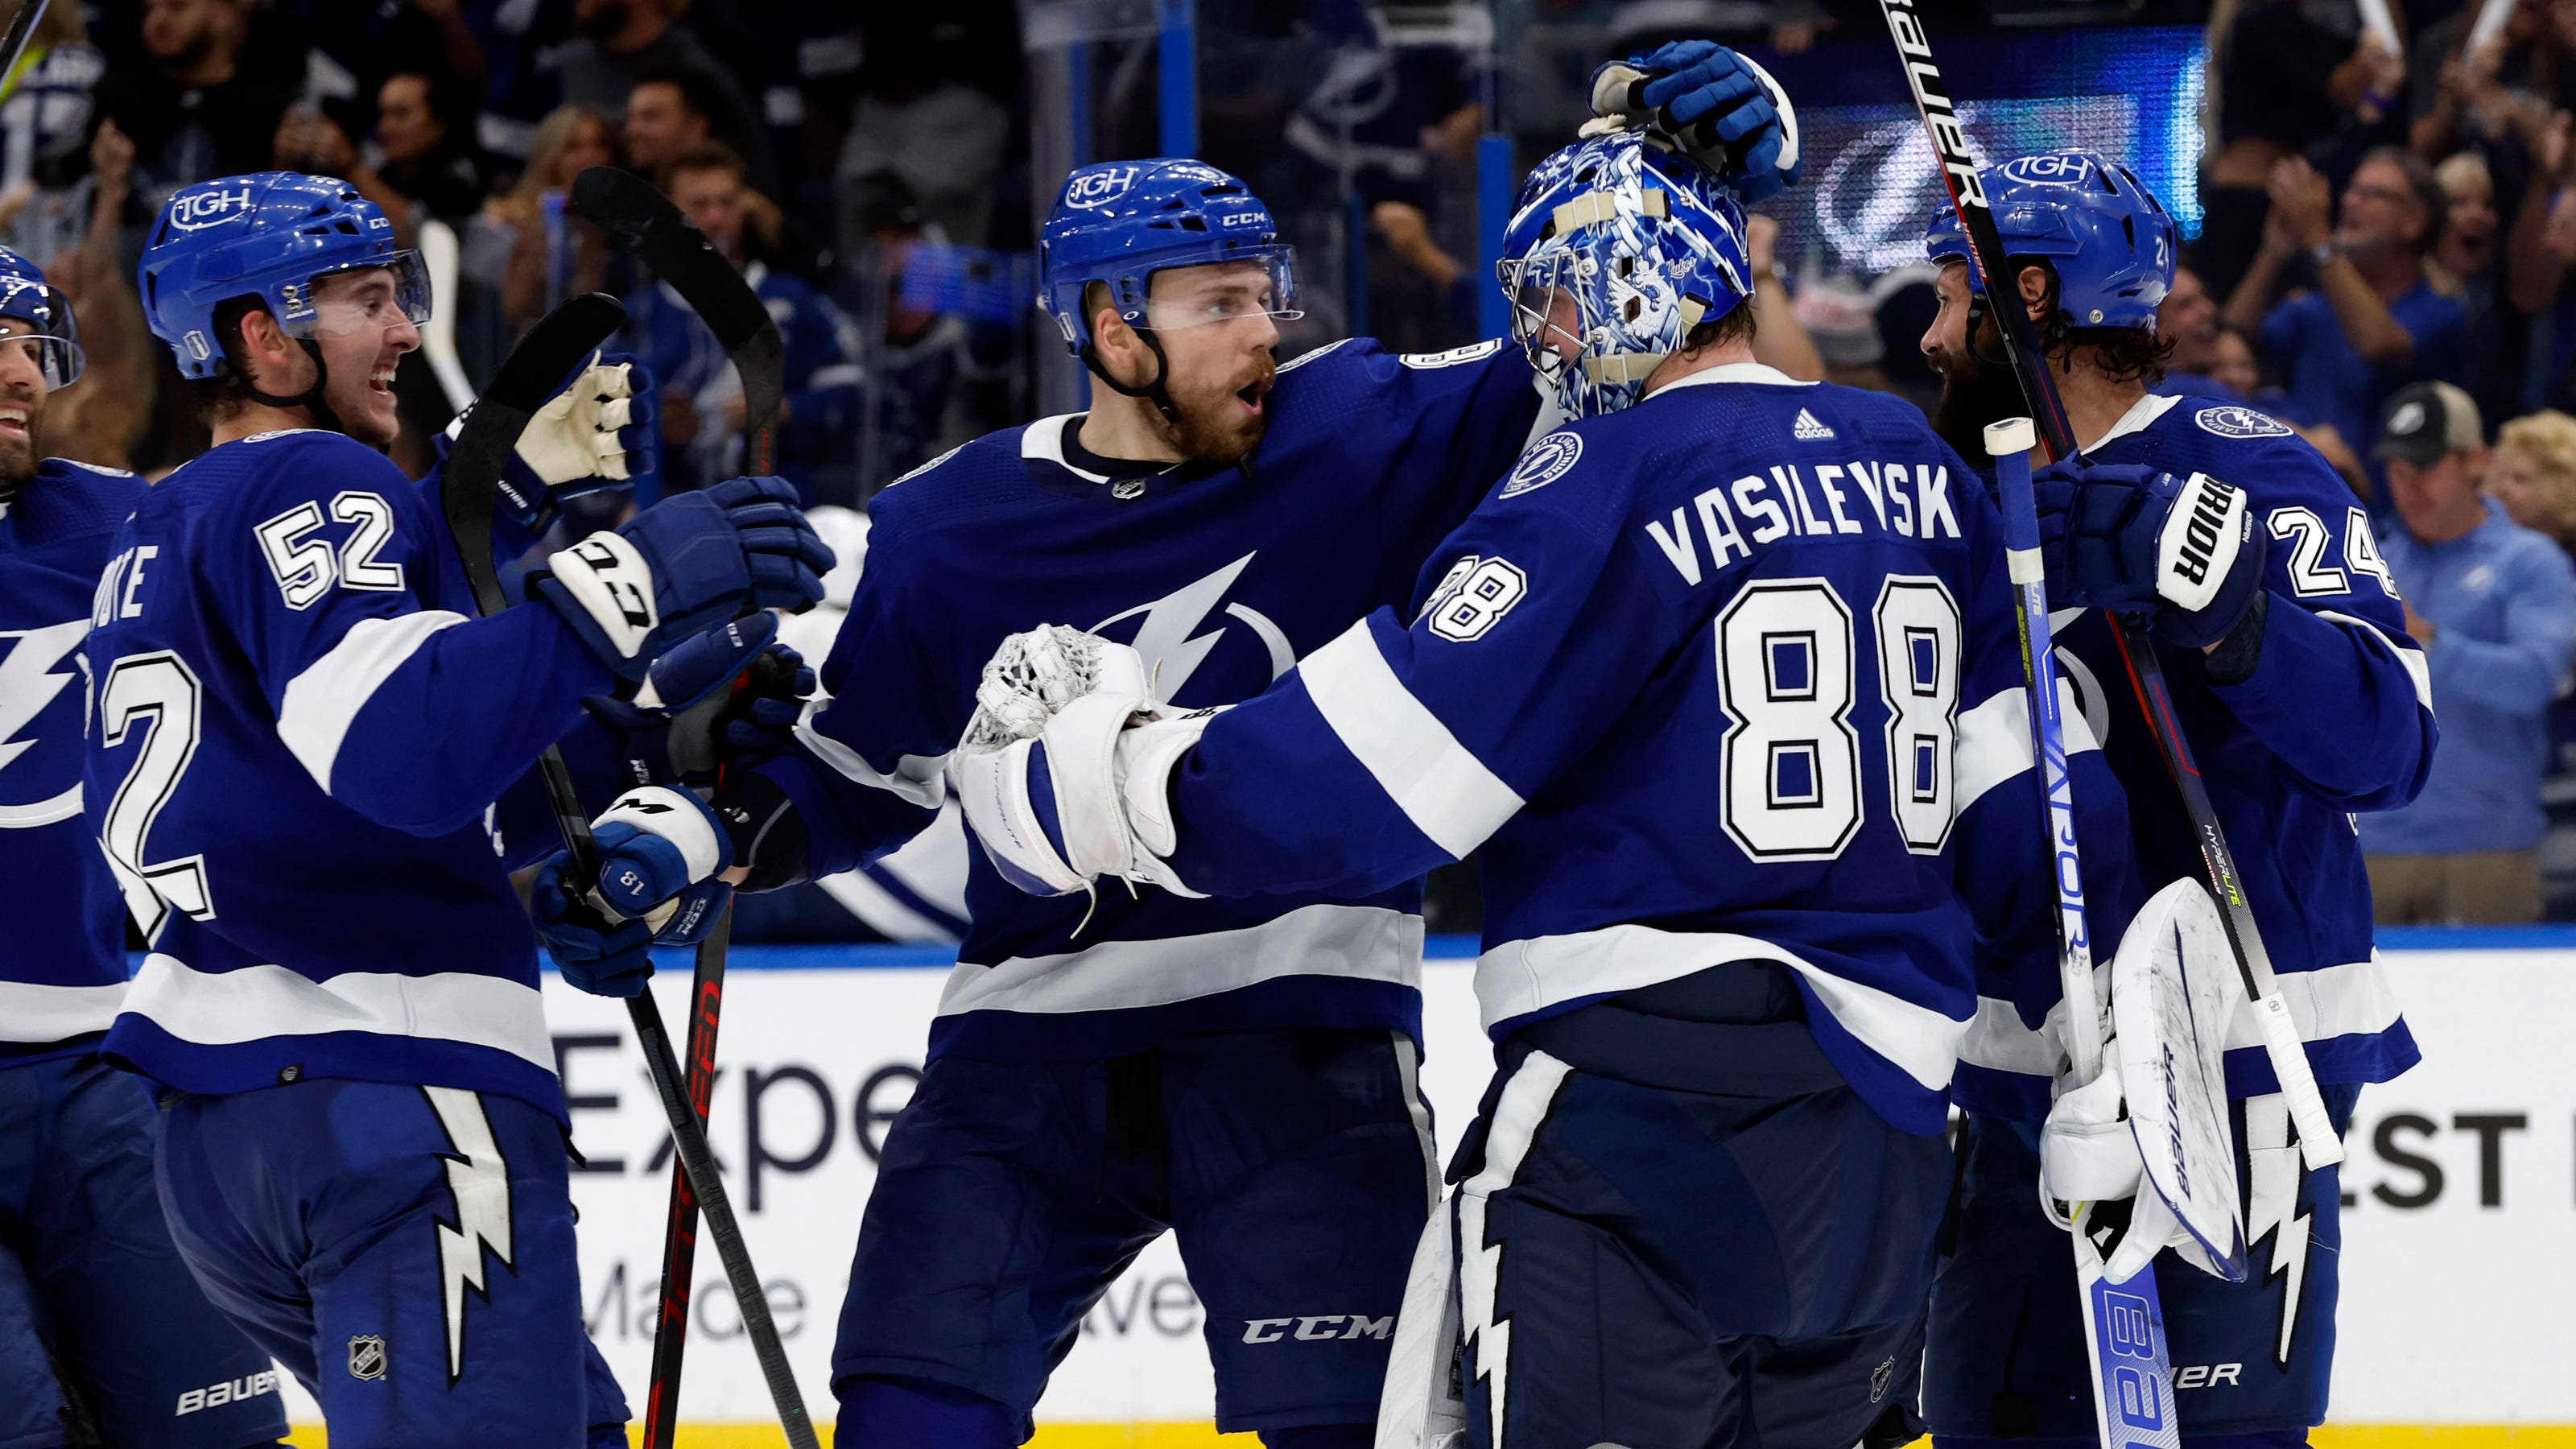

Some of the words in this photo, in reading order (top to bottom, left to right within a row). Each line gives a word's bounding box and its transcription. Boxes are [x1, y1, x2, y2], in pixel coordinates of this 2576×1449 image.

[1881, 0, 1989, 208] AUER
[1074, 168, 1135, 200] TGH
[2017, 155, 2090, 180] TGH
[175, 188, 250, 221] TGH
[1223, 212, 1265, 227] CCM
[1794, 427, 1834, 440] adidas
[253, 490, 406, 611] 52
[2266, 506, 2402, 601] 24
[1714, 572, 1963, 864] 88
[2203, 824, 2242, 907] HYPERLITE
[620, 870, 645, 896] 81
[2162, 1041, 2192, 1203] BAUER
[1241, 1315, 1395, 1344] CCM
